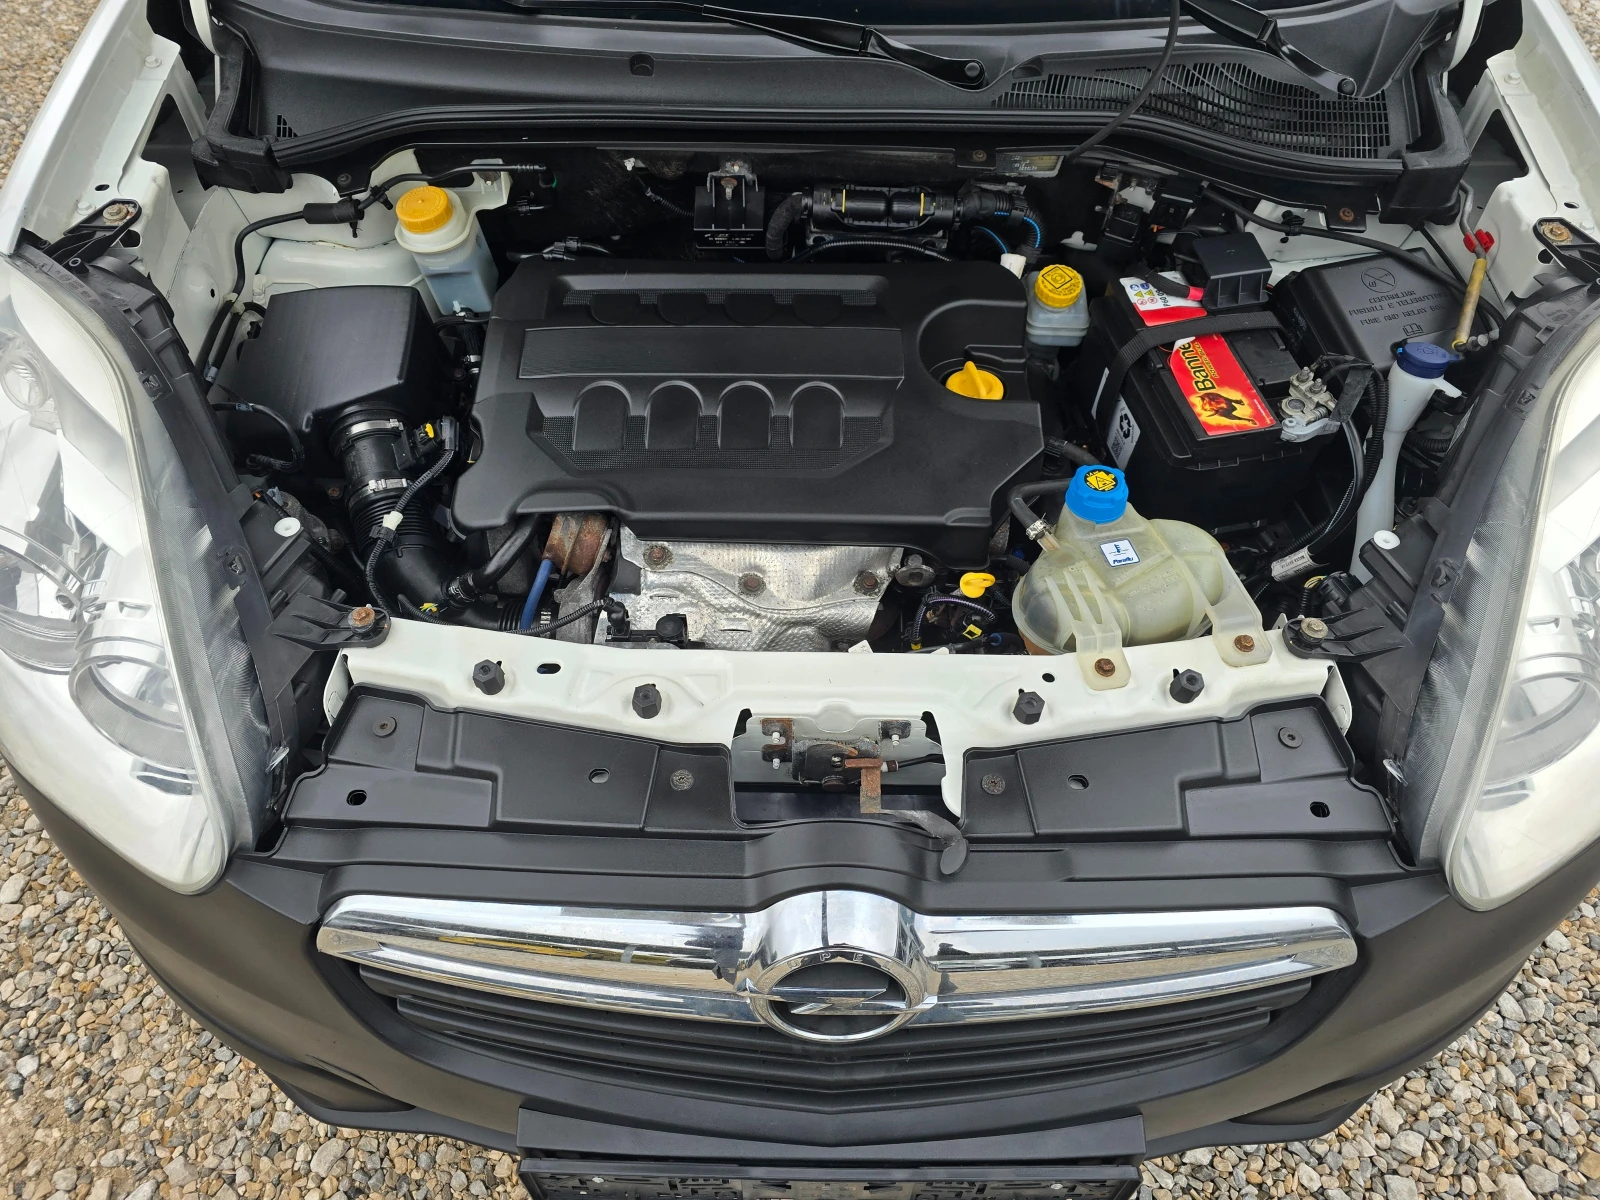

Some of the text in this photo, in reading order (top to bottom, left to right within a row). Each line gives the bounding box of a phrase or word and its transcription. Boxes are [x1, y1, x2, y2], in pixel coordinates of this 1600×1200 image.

[1360, 317, 1381, 326] FUSE
[1384, 312, 1399, 321] AND
[1402, 306, 1428, 318] RELAY
[1177, 341, 1218, 392] Banne
